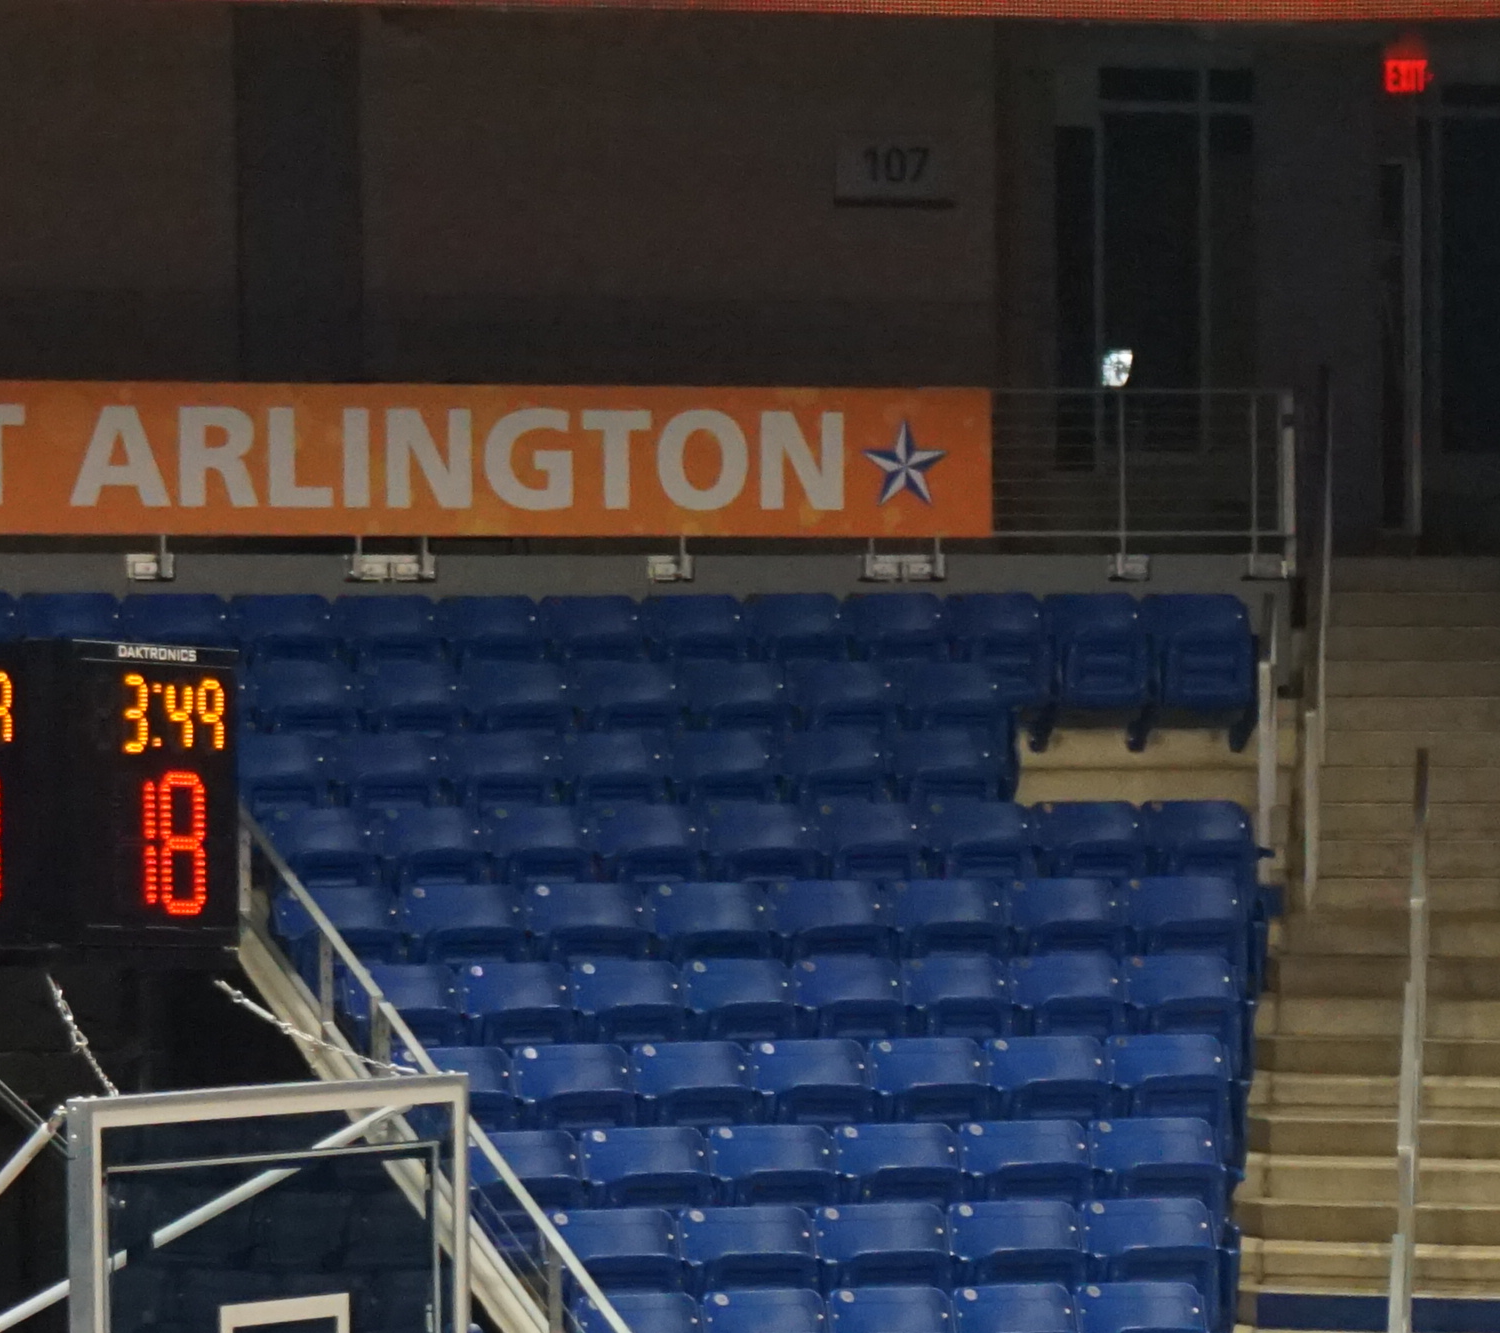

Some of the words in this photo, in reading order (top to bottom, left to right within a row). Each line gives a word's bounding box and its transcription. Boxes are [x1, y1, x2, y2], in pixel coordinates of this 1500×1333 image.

[864, 147, 930, 181] 107
[69, 403, 845, 513] ARLINGTON
[116, 645, 198, 662] DAKTRONICS
[122, 672, 225, 755] 3:49
[143, 770, 207, 916] 18
